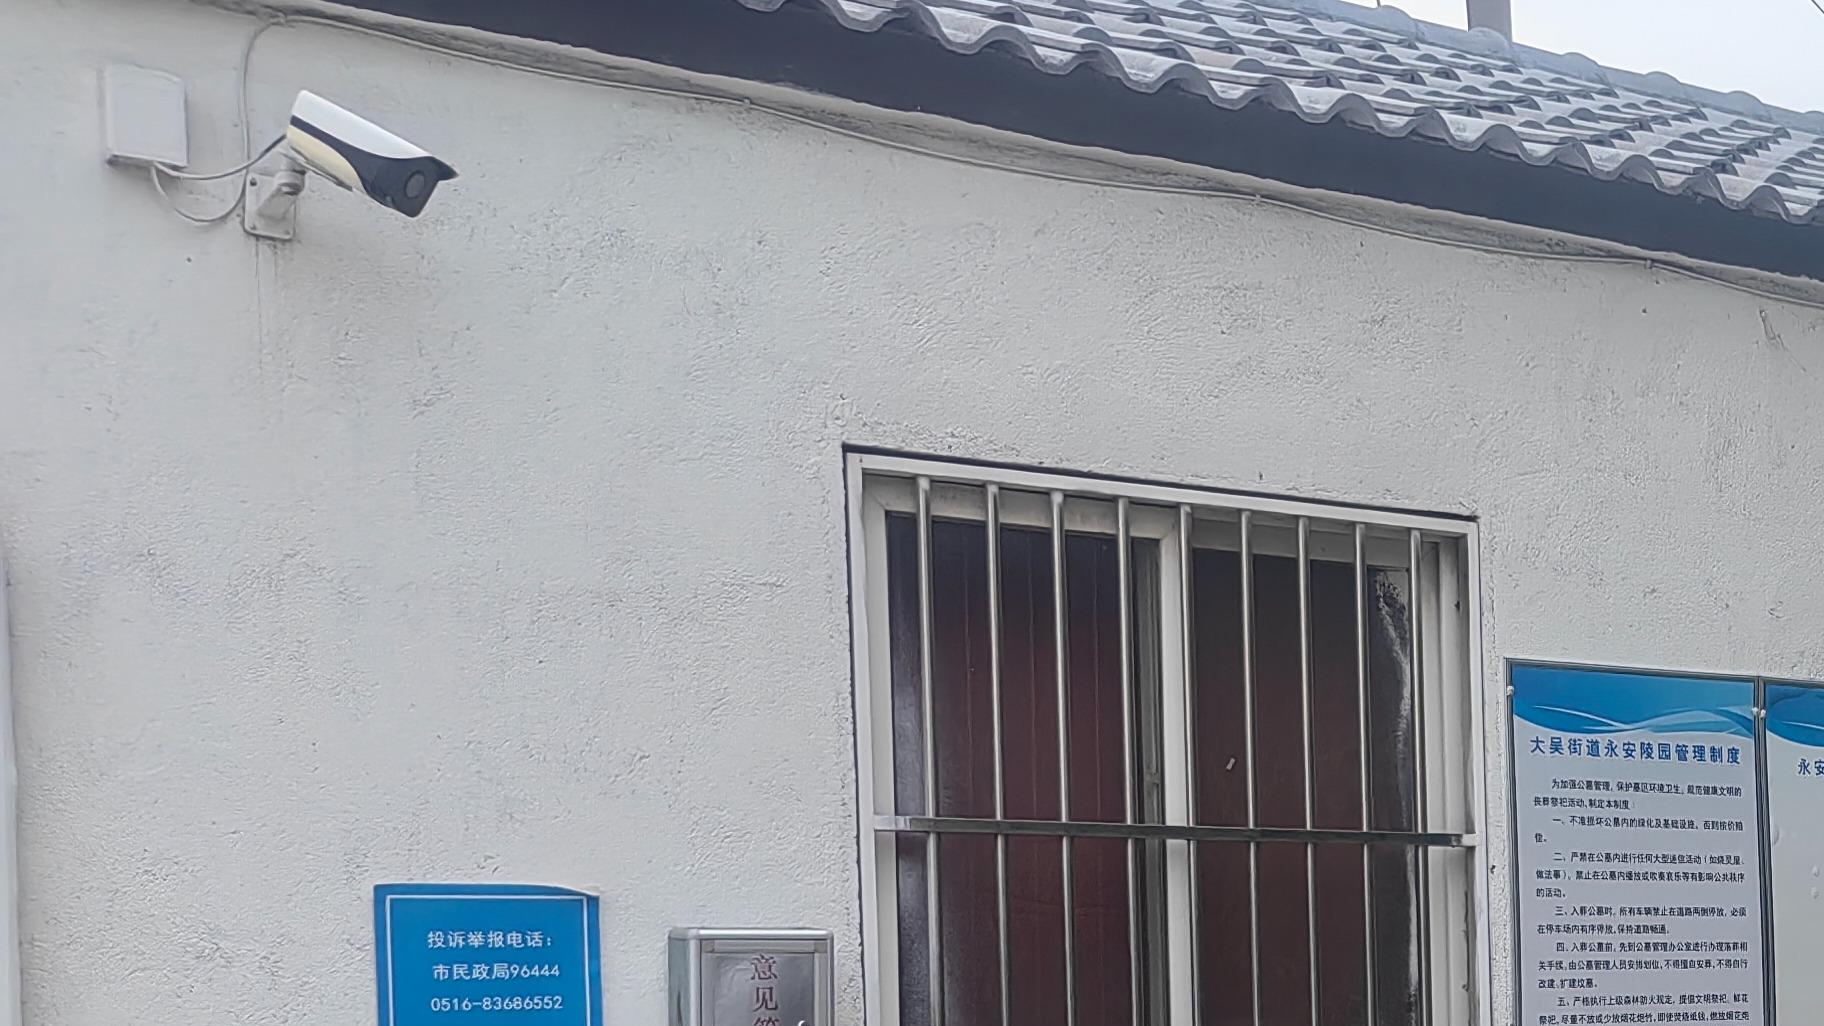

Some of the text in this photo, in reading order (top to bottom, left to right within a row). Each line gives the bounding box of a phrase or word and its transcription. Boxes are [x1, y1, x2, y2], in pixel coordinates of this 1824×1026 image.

[1530, 735, 1742, 766] 大吴街道永安陵园管理制度
[427, 929, 554, 949] 投诉举报电话：
[433, 962, 561, 981] 市民政局96444
[430, 995, 564, 1012] 0516-83686552
